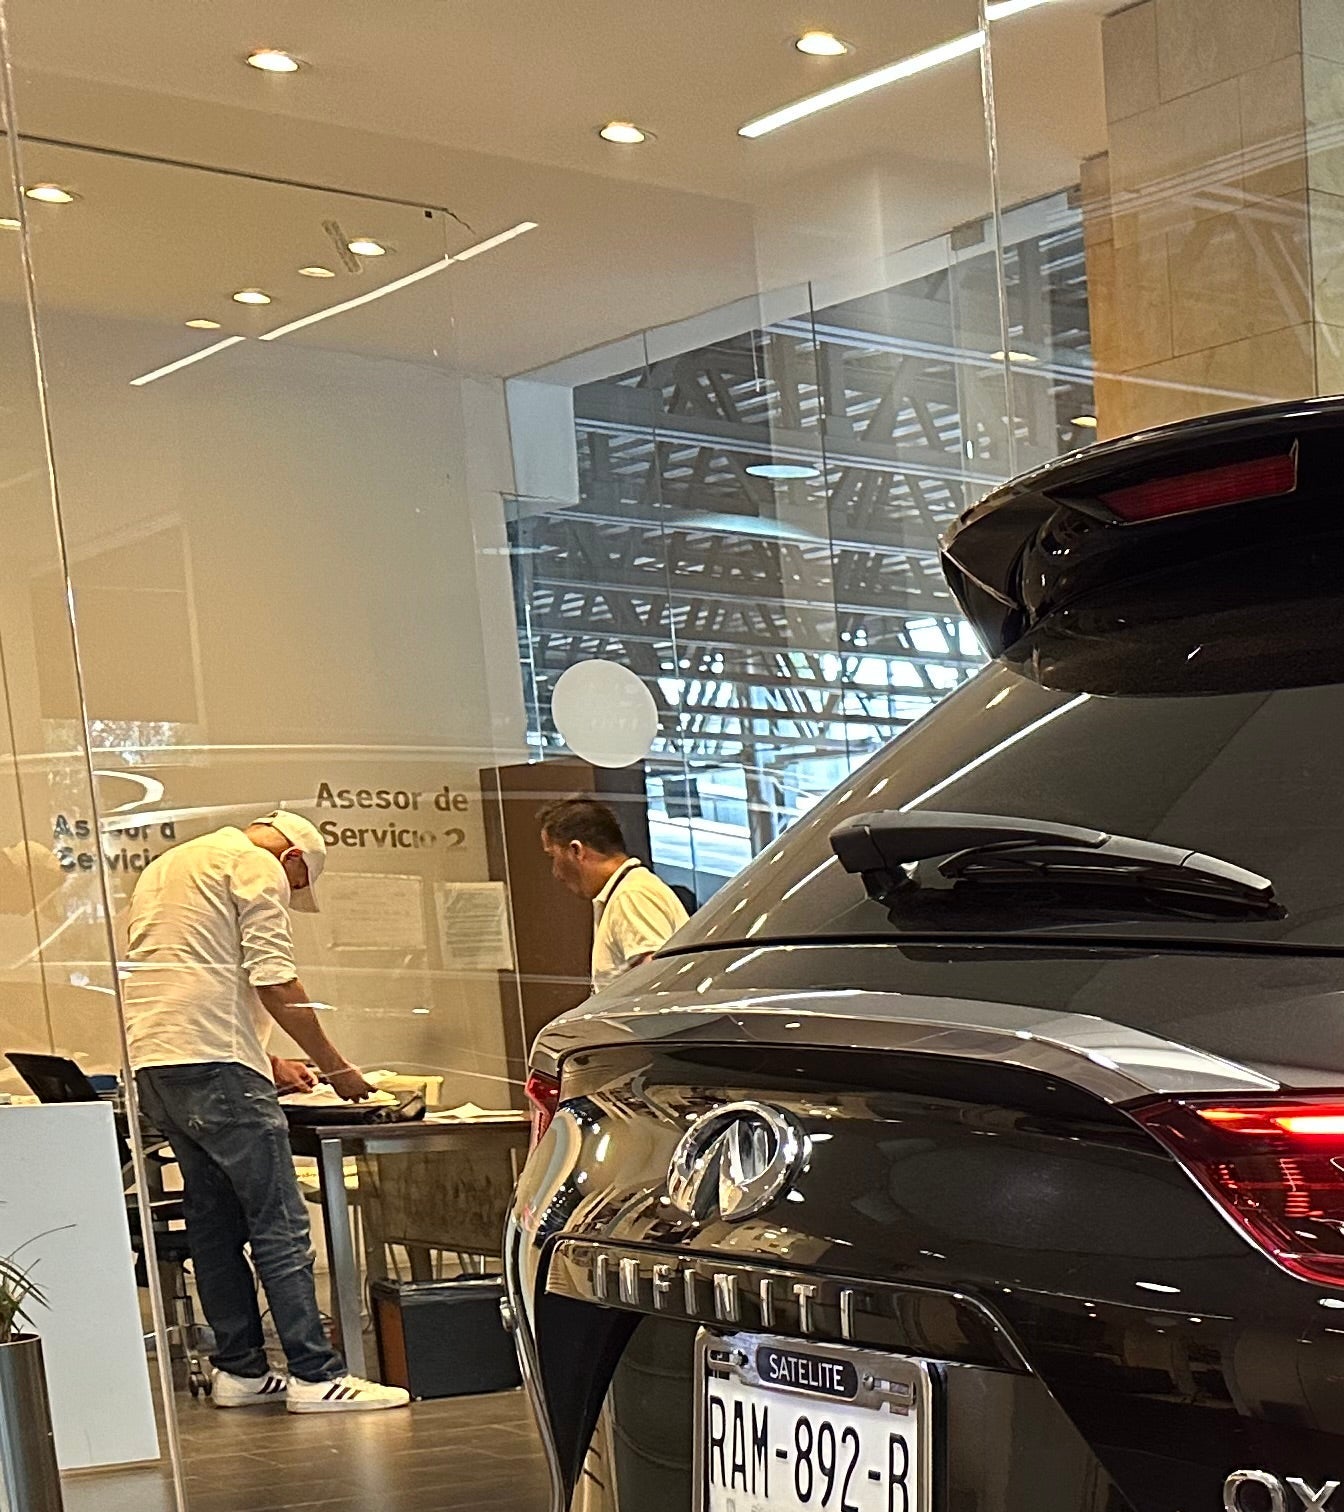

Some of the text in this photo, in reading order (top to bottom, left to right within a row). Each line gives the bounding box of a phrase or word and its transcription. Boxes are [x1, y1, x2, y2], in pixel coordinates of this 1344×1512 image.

[315, 782, 469, 812] Asesor de
[319, 820, 467, 851] Servicio 2
[592, 1254, 855, 1340] INFINITI
[769, 1353, 845, 1392] SATELITE
